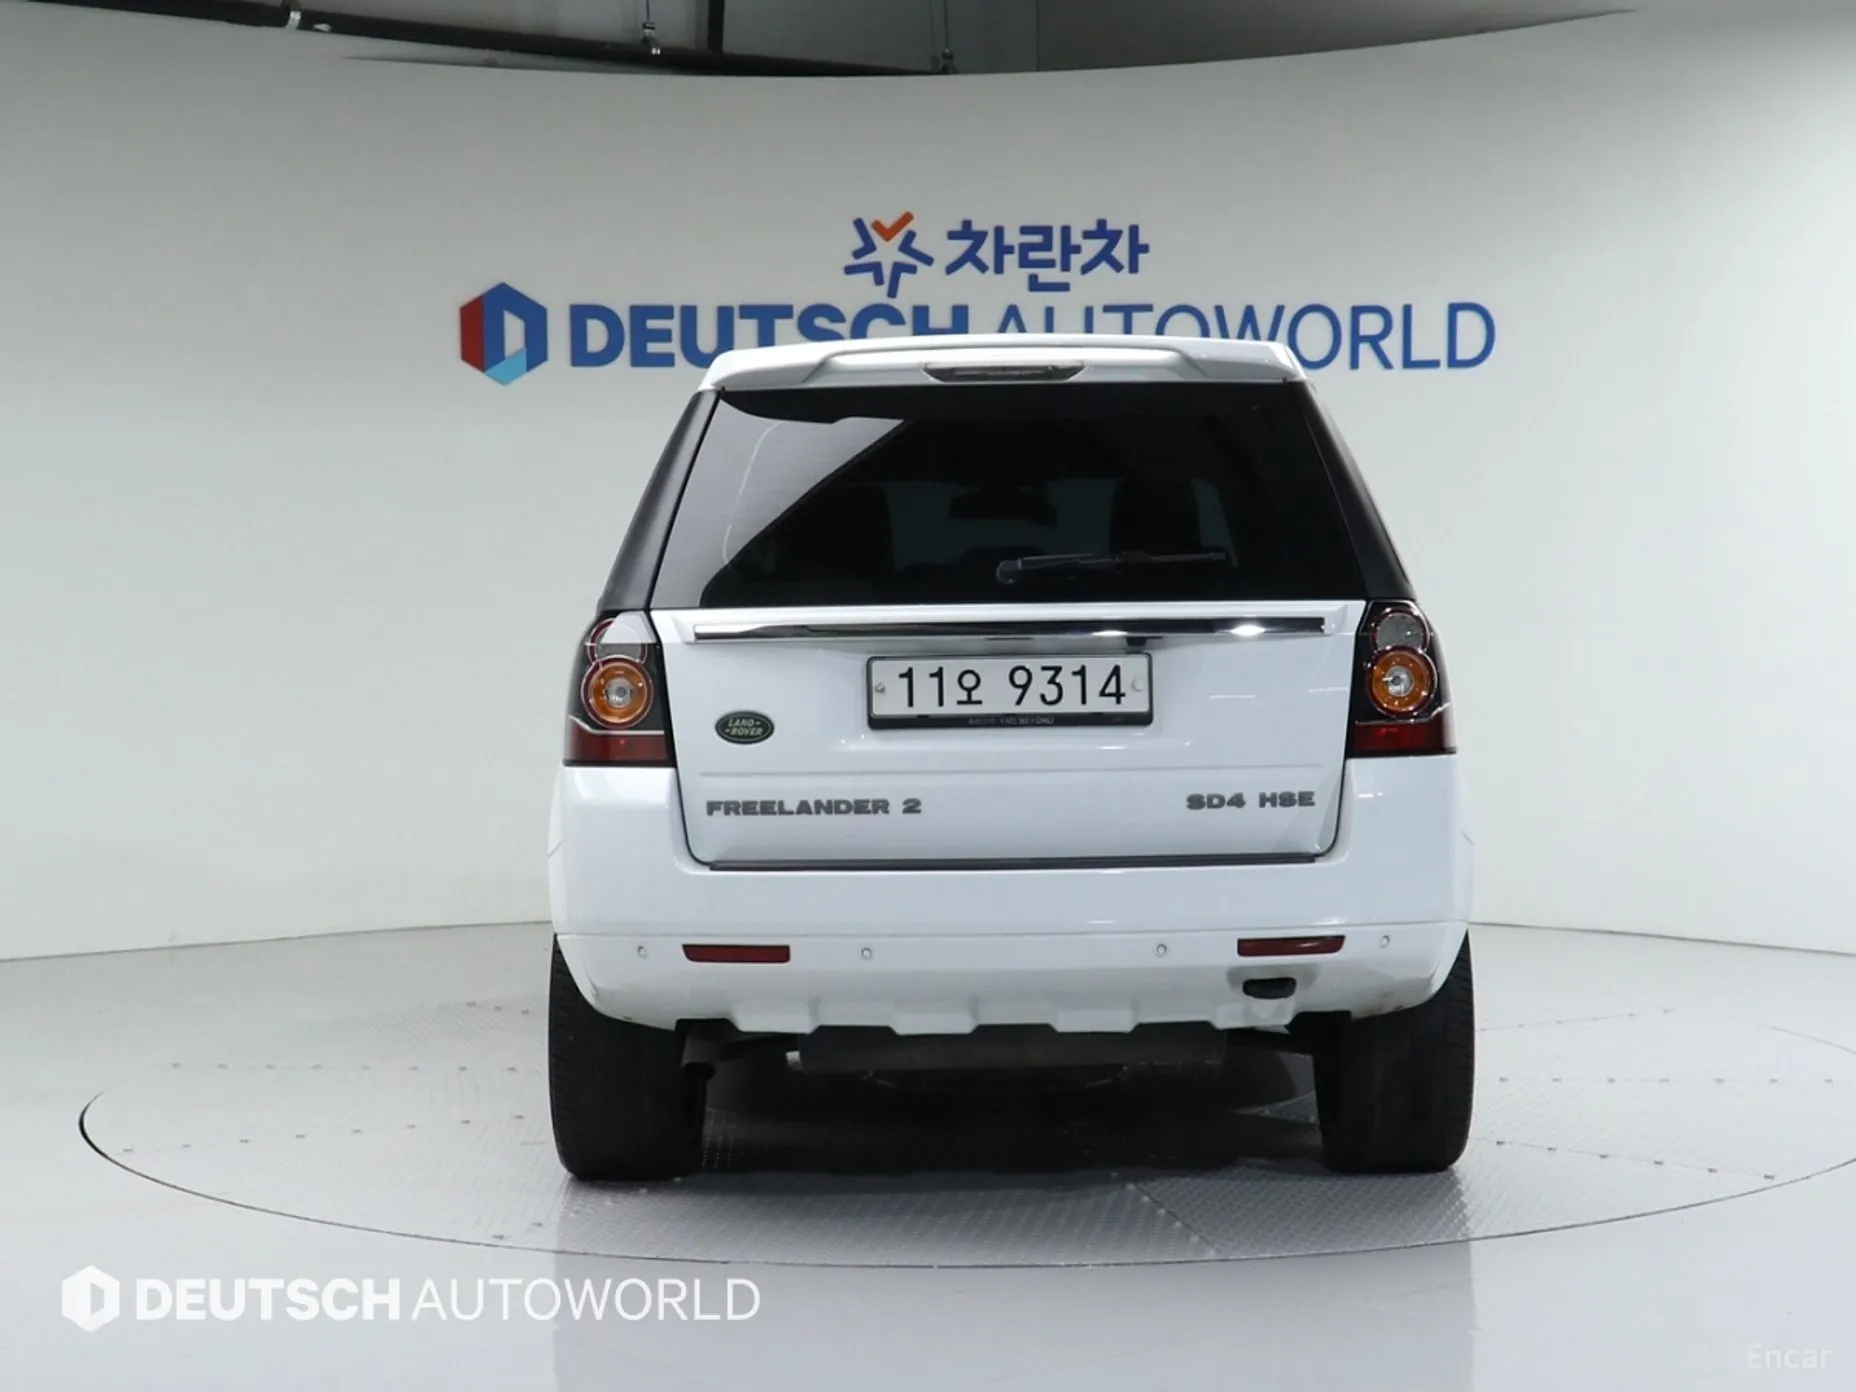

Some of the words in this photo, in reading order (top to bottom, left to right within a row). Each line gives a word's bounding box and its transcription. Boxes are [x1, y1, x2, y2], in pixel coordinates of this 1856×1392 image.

[945, 218, 1151, 293] 차란차
[898, 666, 984, 708] 11오
[1007, 664, 1126, 706] 9314
[705, 798, 890, 817] FREELANDER
[901, 797, 922, 815] 2
[1186, 792, 1247, 811] SD4
[1258, 790, 1316, 809] HSE
